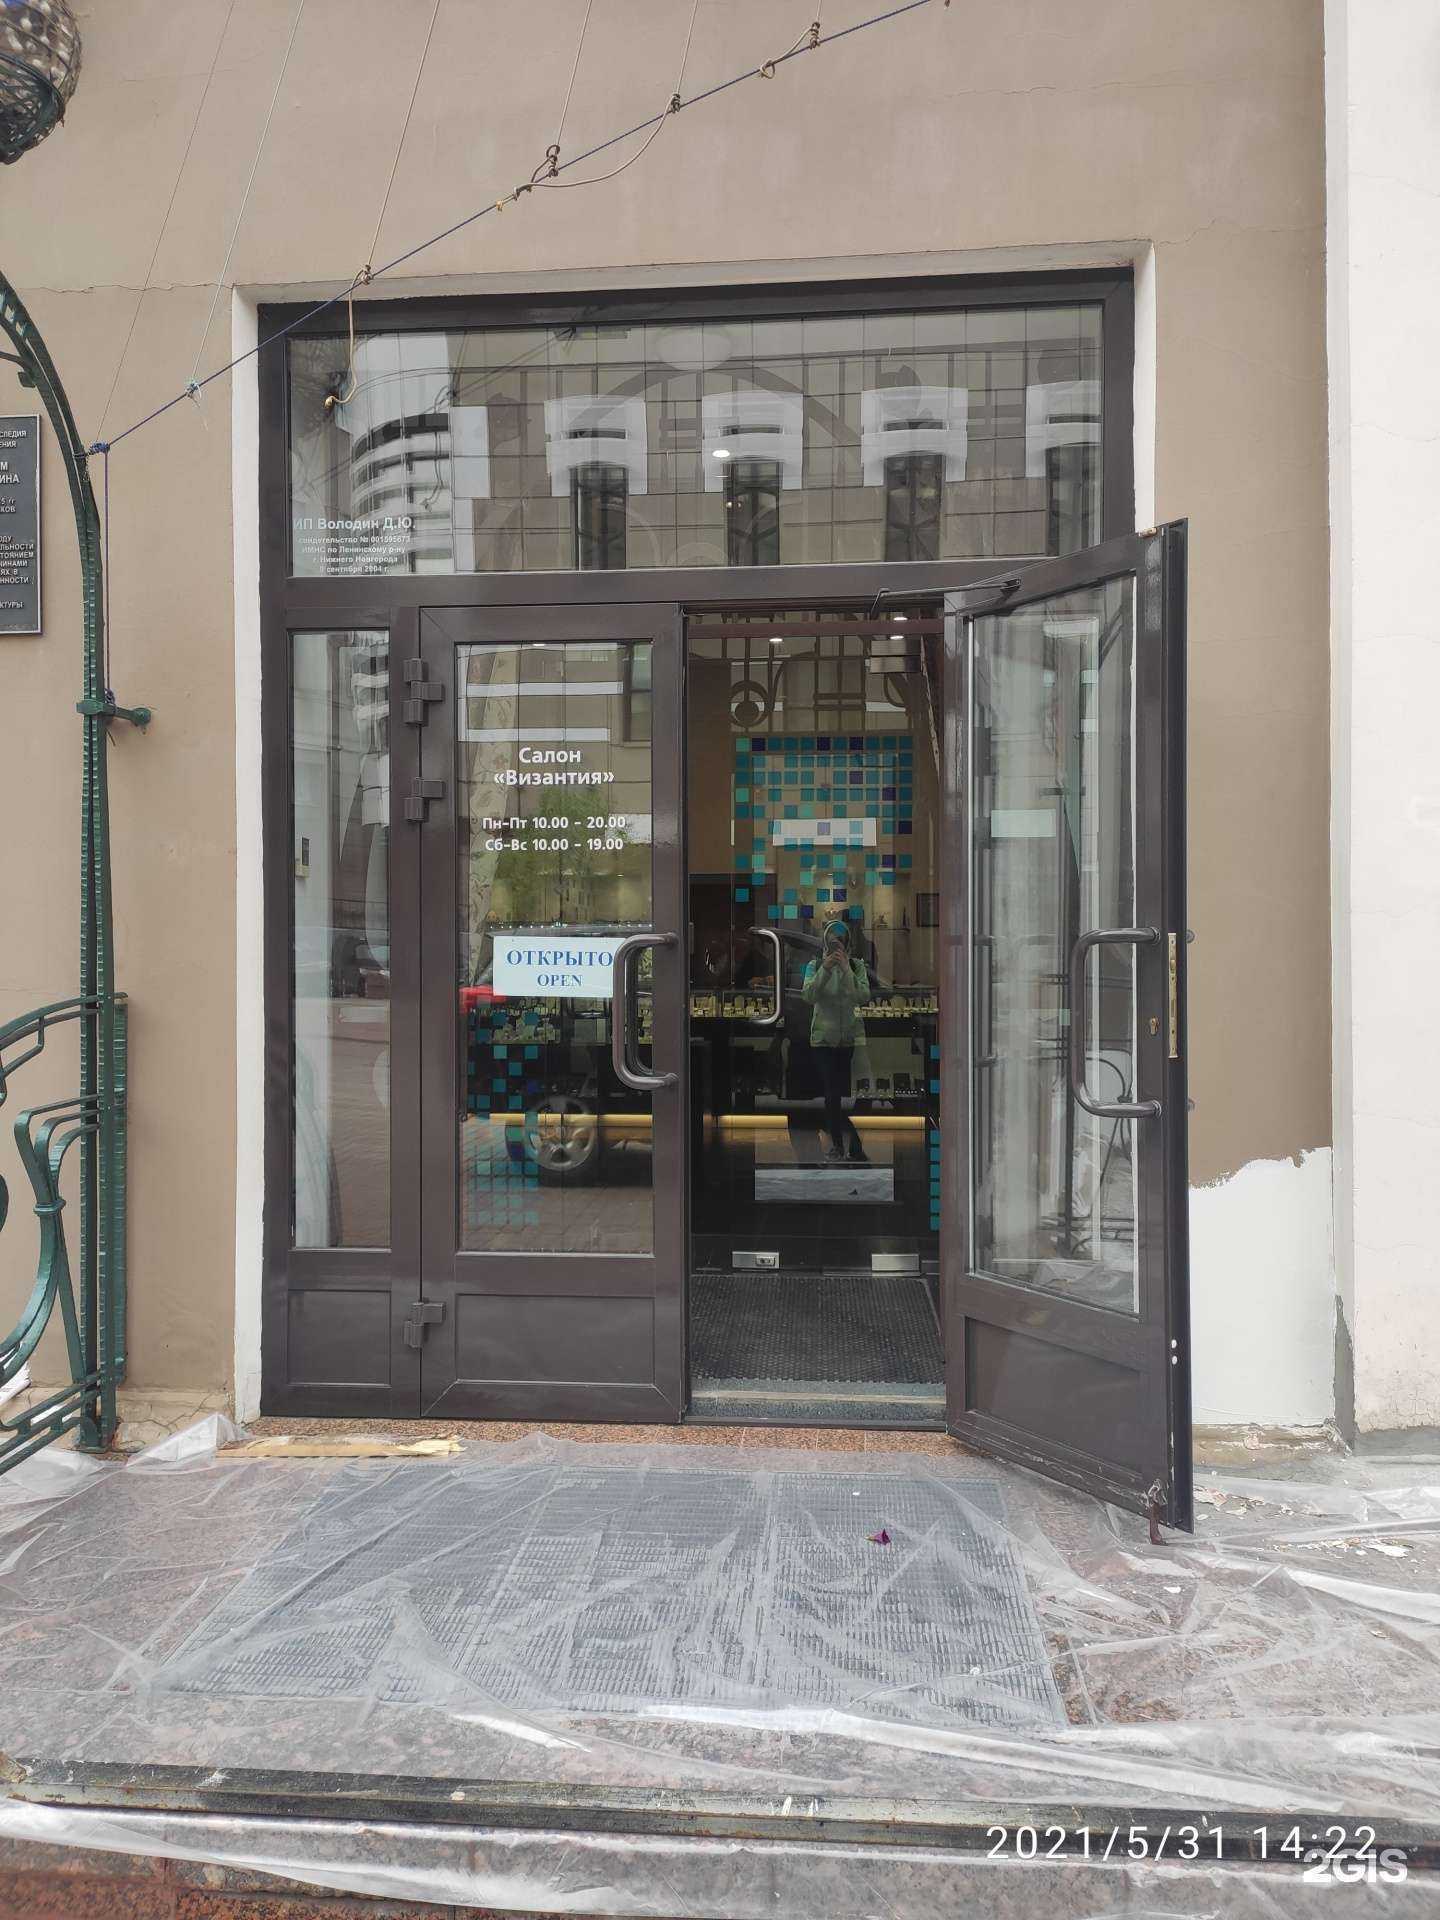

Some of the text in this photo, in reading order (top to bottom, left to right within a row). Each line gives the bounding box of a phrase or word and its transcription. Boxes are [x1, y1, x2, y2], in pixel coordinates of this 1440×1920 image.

[294, 516, 416, 531] ИП Володин Д.Ю.
[518, 747, 582, 764] Салон
[494, 769, 615, 786] «Византия»
[482, 817, 528, 830] Пн-Пт
[532, 816, 569, 829] 10.00
[586, 816, 626, 829] 20.00
[485, 838, 528, 851] Сб-Вс
[532, 838, 569, 850] 10.00
[586, 838, 624, 850] 19.00
[506, 950, 614, 967] ОТКРЫТО
[537, 974, 583, 987] OPEN
